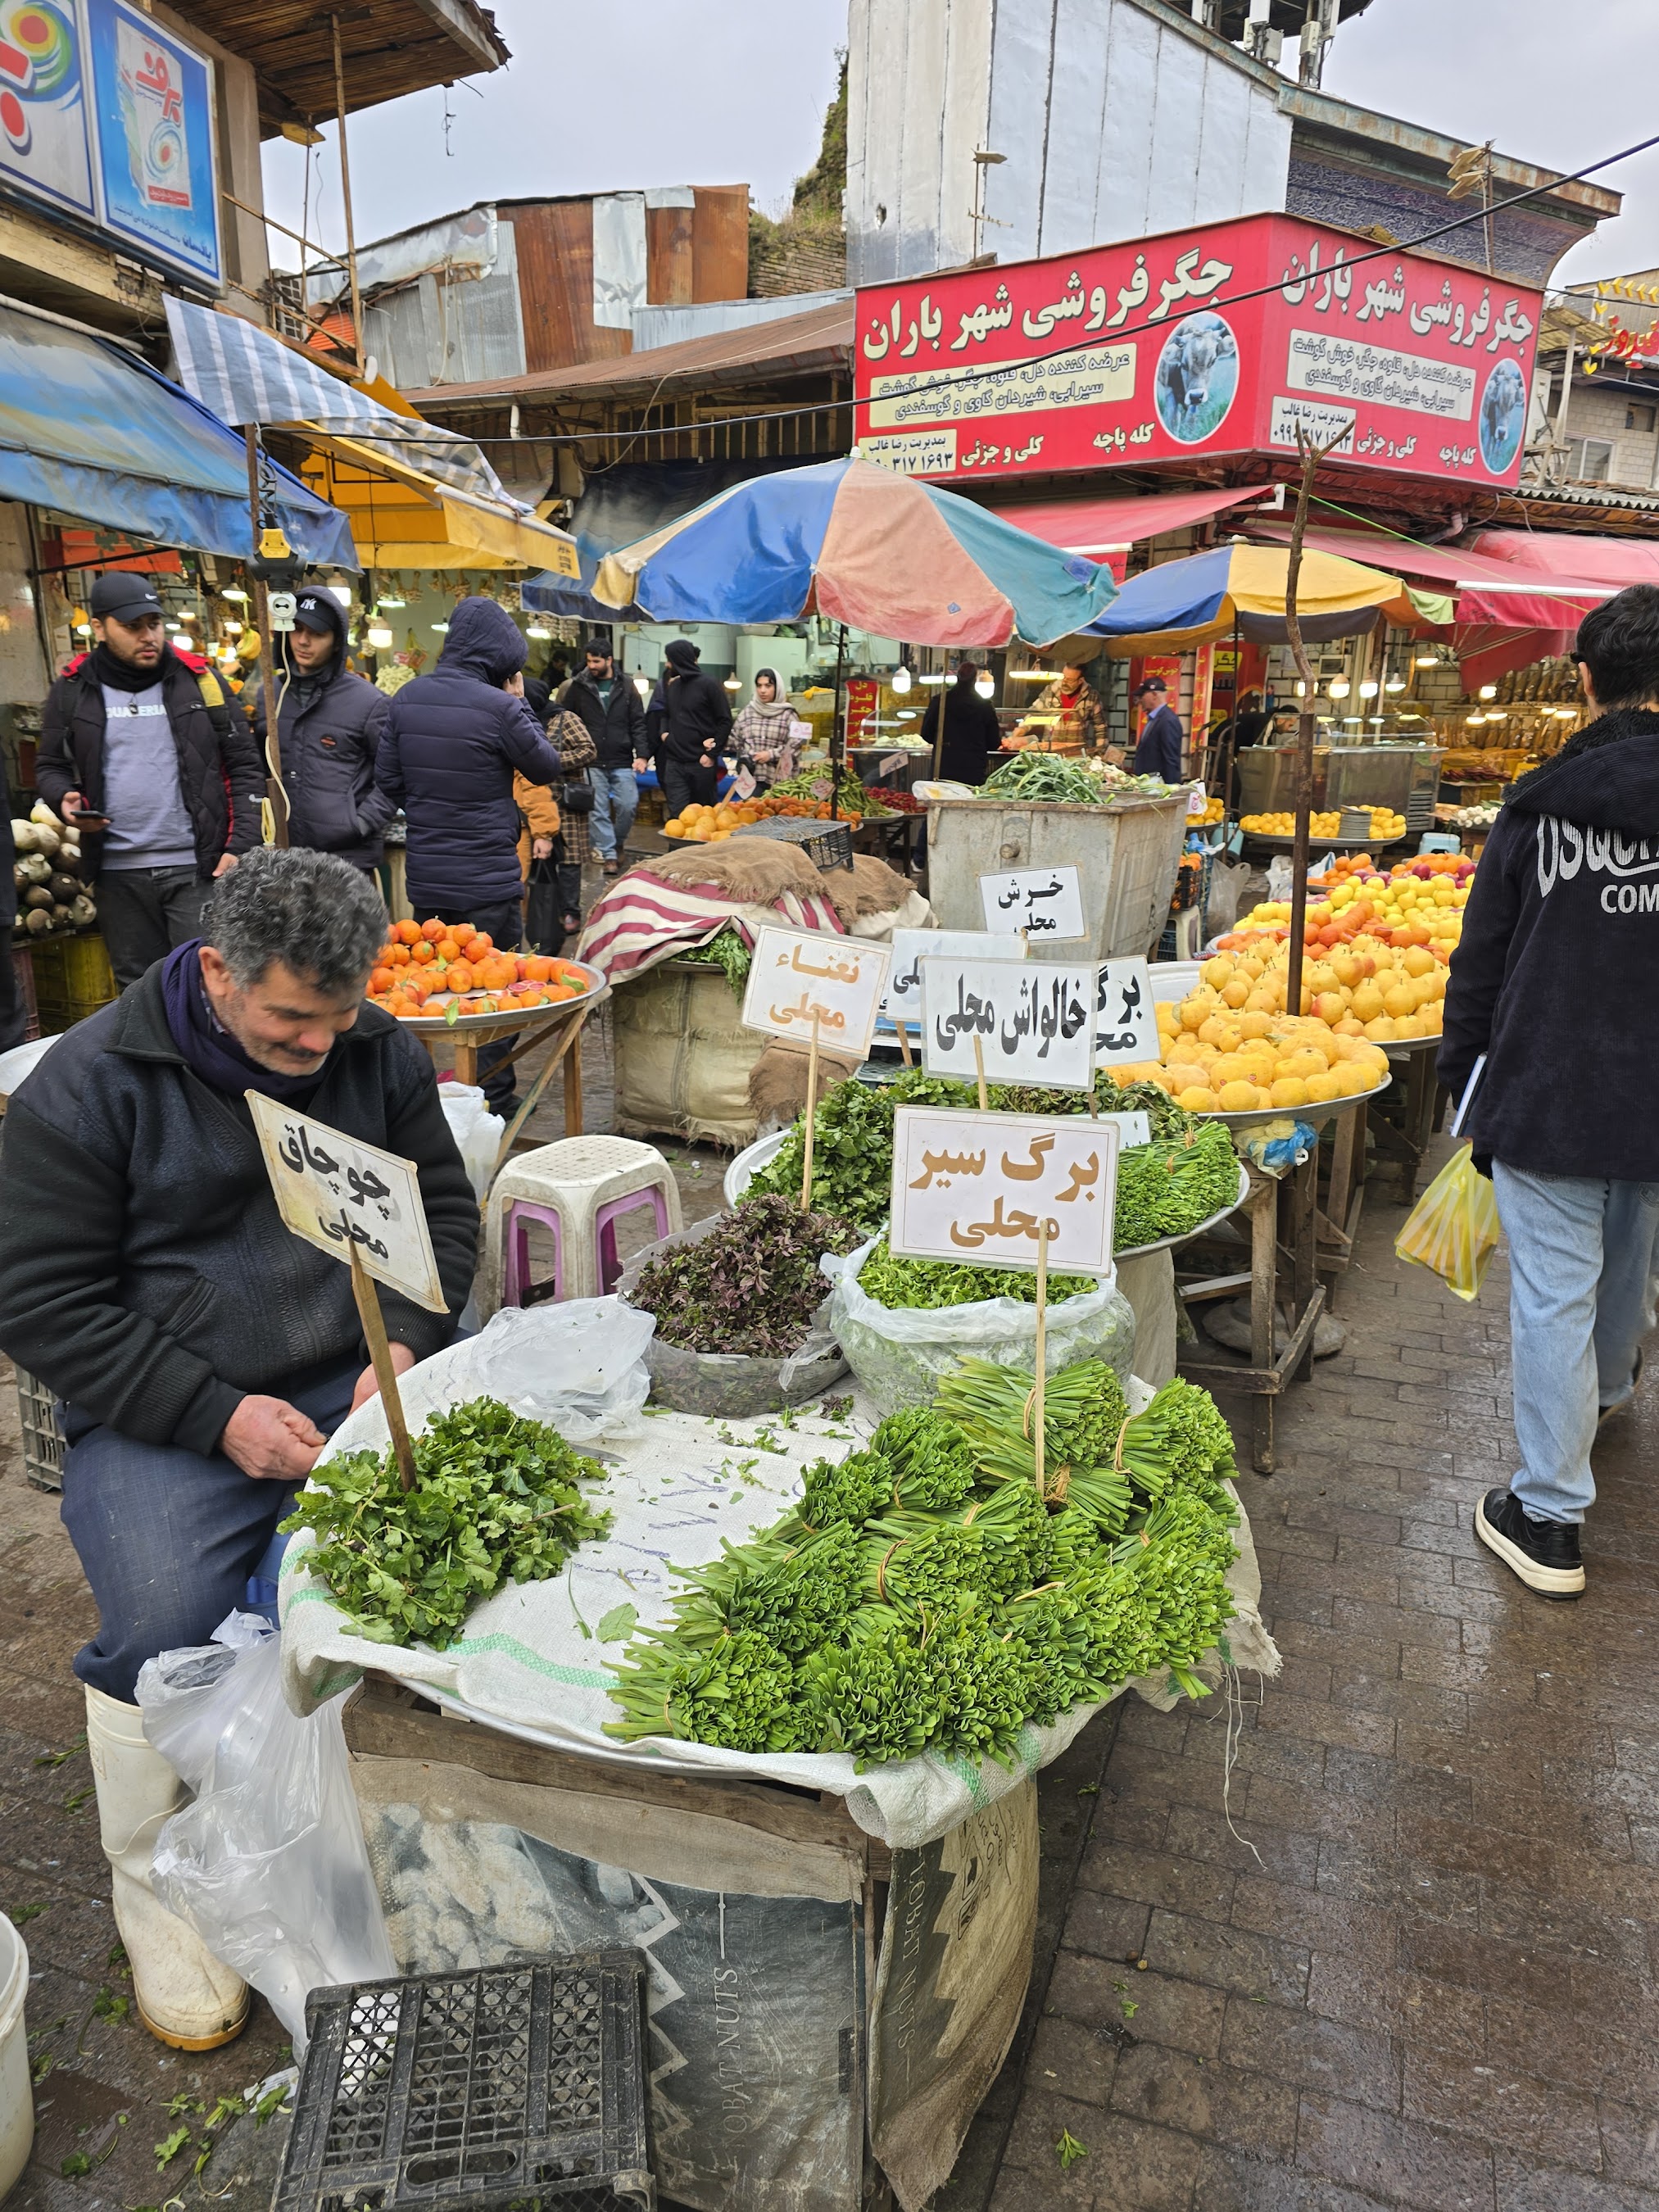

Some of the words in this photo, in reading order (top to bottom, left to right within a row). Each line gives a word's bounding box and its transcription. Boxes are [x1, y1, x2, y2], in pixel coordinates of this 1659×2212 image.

[1281, 240, 1352, 313] باران
[1356, 265, 1405, 321] شهر
[863, 293, 941, 360] باران
[950, 283, 1013, 351] شهر
[1088, 352, 1130, 370] عرضه
[1294, 338, 1327, 361] گوشت
[1327, 344, 1354, 366] خوش
[1049, 356, 1086, 376] کننده
[1421, 367, 1447, 383] کننده
[1305, 368, 1352, 392] گوسفندی
[1352, 379, 1360, 393] و
[1361, 376, 1384, 397] گاوی
[1448, 371, 1472, 392] عرضه
[964, 392, 993, 413] گاوی
[996, 385, 1046, 409] شیردان
[1384, 382, 1420, 404] شیردان
[895, 394, 951, 420] گوسفندی
[954, 400, 961, 414] و
[1282, 401, 1300, 415] غالب
[1303, 405, 1316, 424] رضا
[1318, 409, 1348, 426] بمدیریت
[909, 437, 946, 450] بمدیریت
[1092, 426, 1126, 454] پاچه
[1129, 421, 1155, 444] کله
[1357, 426, 1385, 457] جزئی
[868, 439, 889, 454] غالب
[891, 438, 907, 452] رضا
[961, 439, 999, 468] جزئی
[1002, 446, 1011, 464] و
[1014, 435, 1045, 463] کلی
[1386, 441, 1394, 458] و
[1395, 435, 1417, 459] کلی
[1439, 444, 1460, 469] پاچه
[1461, 446, 1477, 465] کله
[998, 873, 1063, 909] خرش
[775, 944, 861, 983] نعناء
[769, 992, 845, 1028] محلی
[936, 973, 995, 1052] محلی
[1001, 976, 1087, 1058] خالواش
[279, 1124, 391, 1221] چوچاق
[909, 1148, 986, 1190] سیر
[1001, 1132, 1099, 1203] برگ
[950, 1195, 1060, 1248] محلی
[318, 1208, 389, 1260] محلی
[714, 1966, 741, 2049] NUTS
[898, 1965, 918, 2049] NUTS
